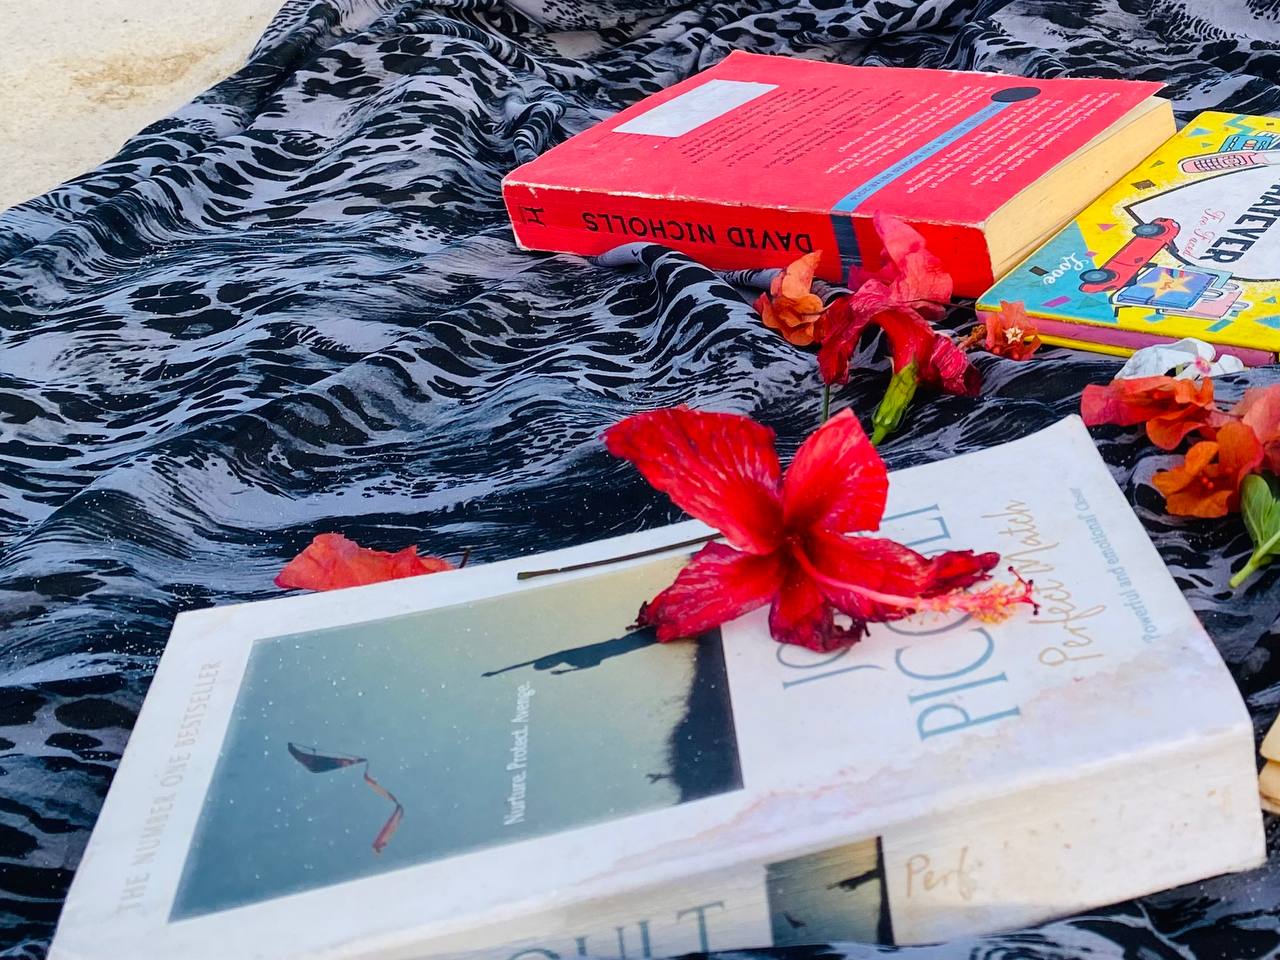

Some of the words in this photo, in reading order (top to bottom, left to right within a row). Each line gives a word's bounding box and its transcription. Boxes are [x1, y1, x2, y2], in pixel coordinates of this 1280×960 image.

[582, 211, 714, 241] NICHOLLS
[728, 229, 813, 253] DAVID
[1043, 252, 1090, 286] Love
[980, 499, 1060, 575] Match
[1105, 566, 1133, 588] and
[1028, 579, 1107, 667] Perfect
[174, 660, 223, 748] BESTSELLER
[511, 681, 536, 723] Avenge.
[160, 752, 193, 787] ONE
[506, 726, 529, 771] Protect.
[503, 770, 527, 826] Nurture.
[132, 791, 178, 866] NUMBER
[117, 872, 150, 914] THE
